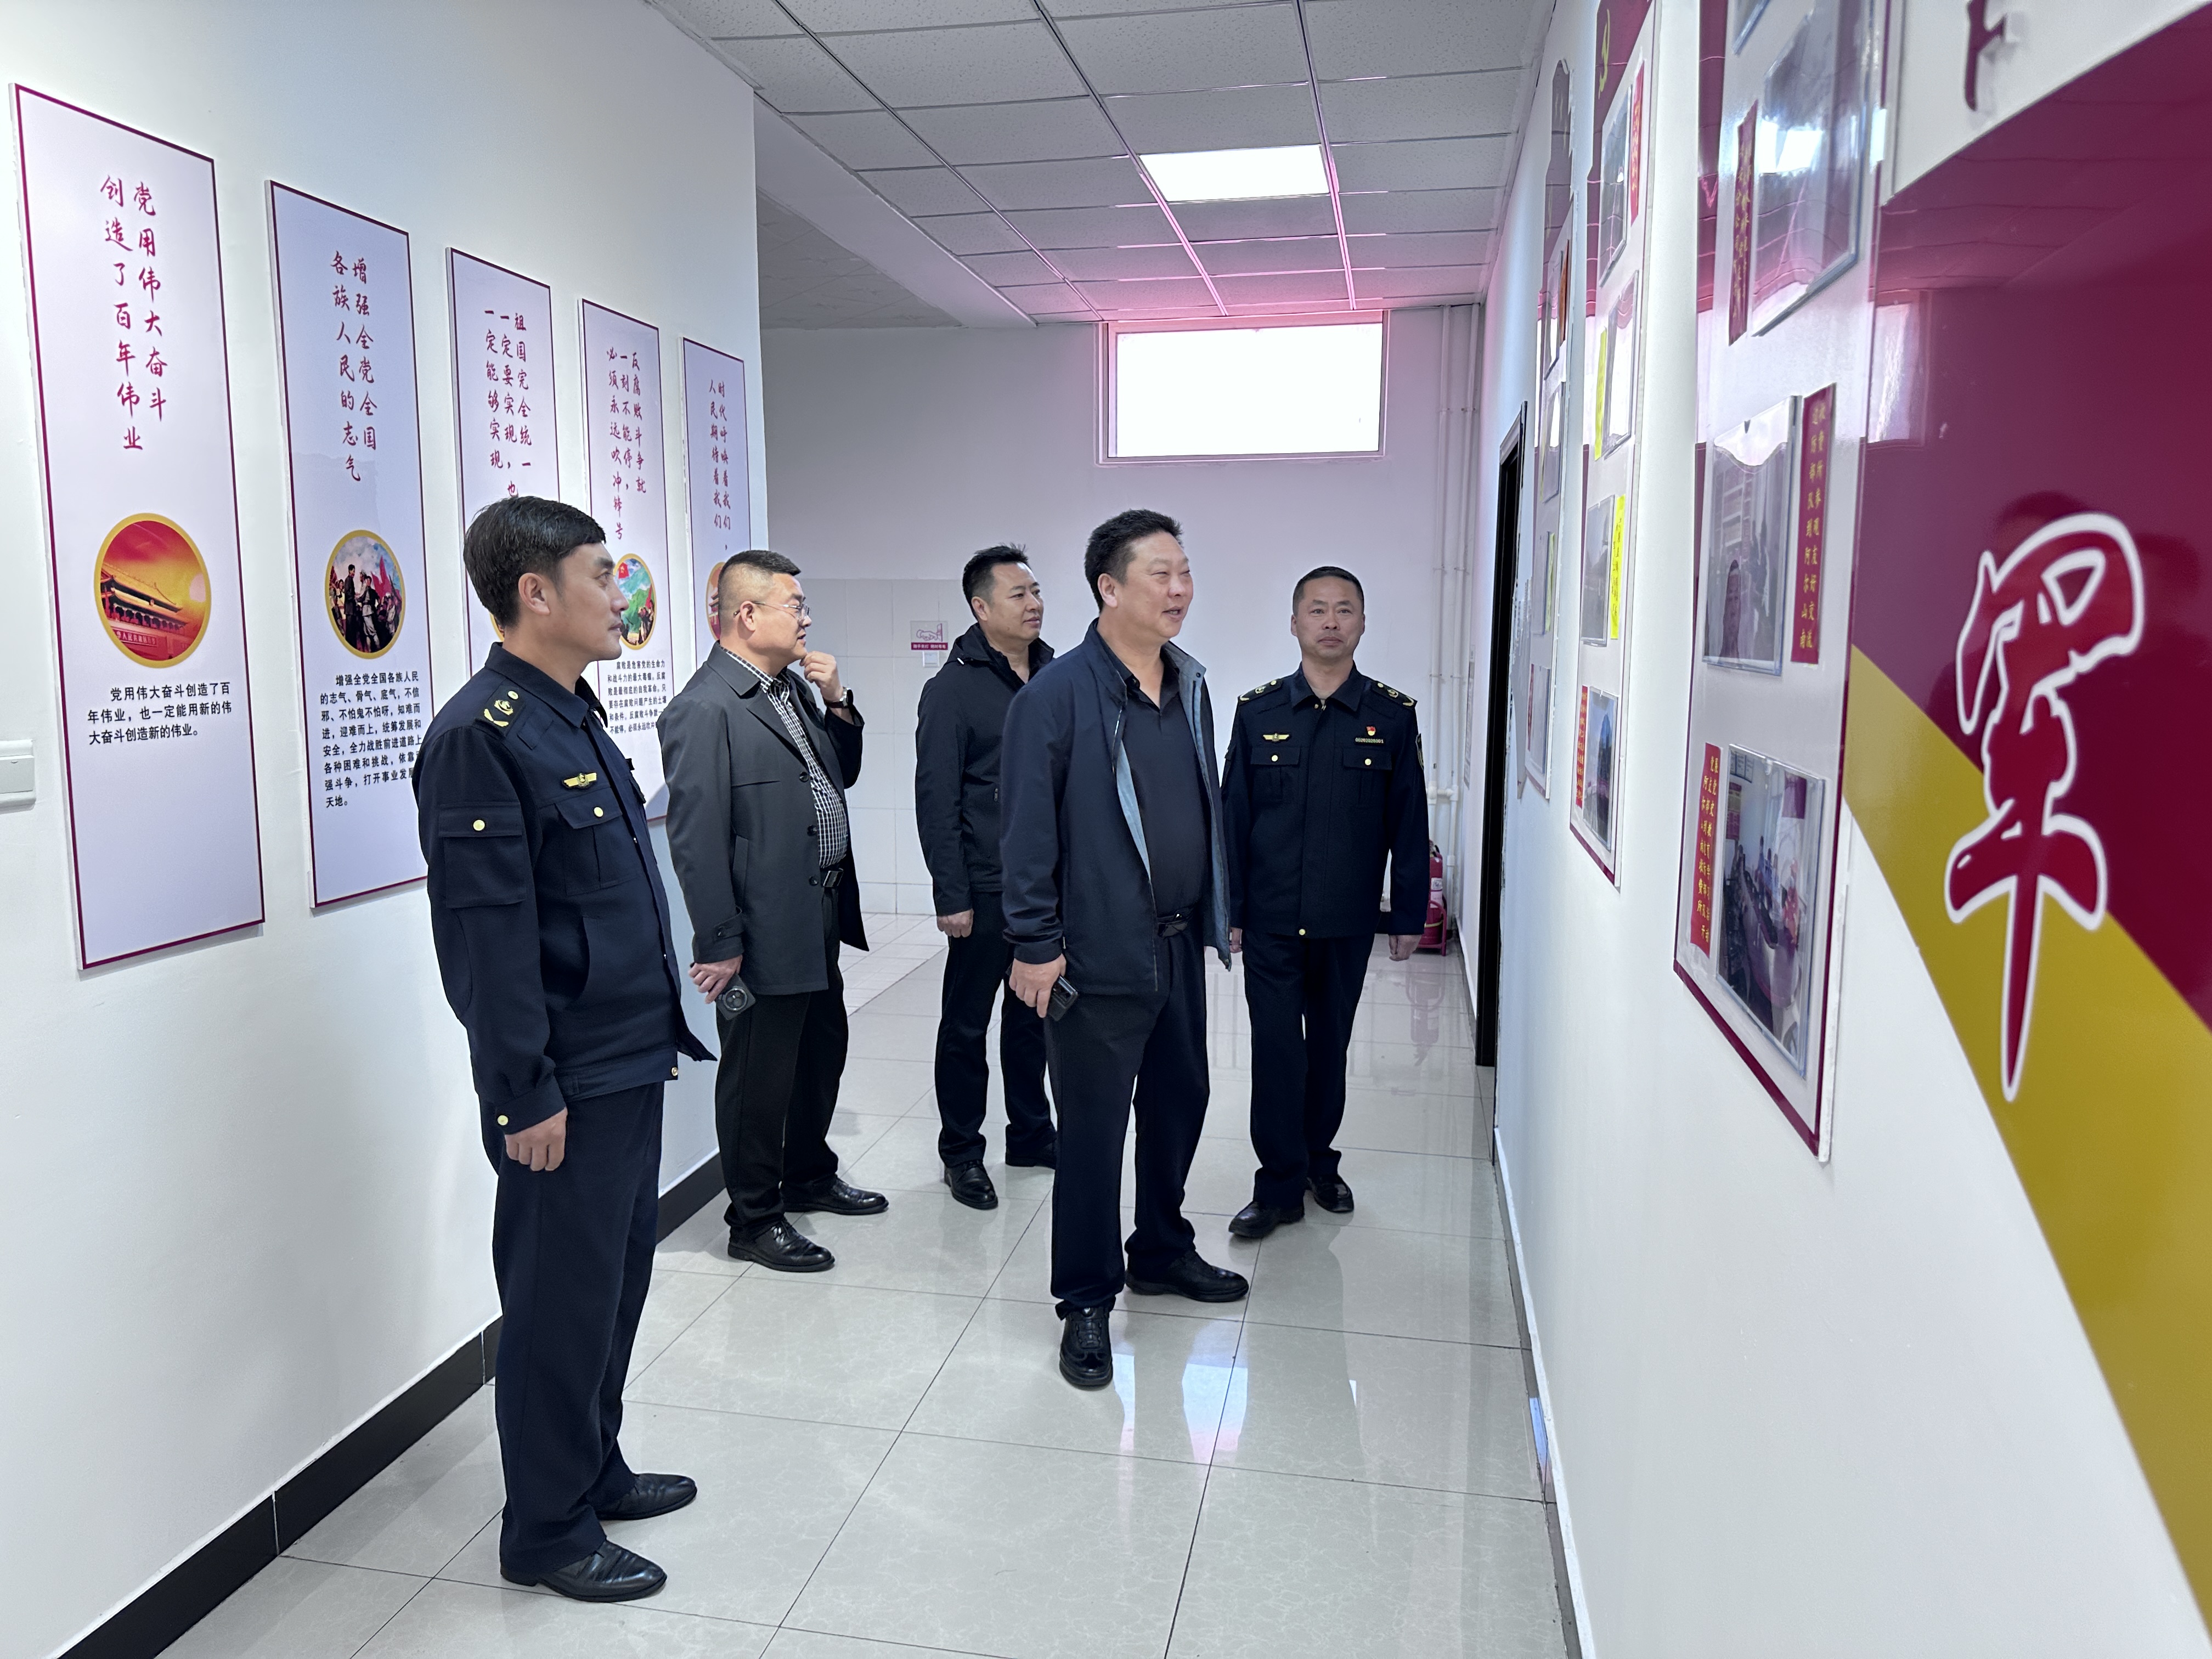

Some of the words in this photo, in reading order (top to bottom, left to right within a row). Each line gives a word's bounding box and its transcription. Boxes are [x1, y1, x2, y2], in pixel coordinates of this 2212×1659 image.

[100, 175, 143, 450] 创造了百年伟业
[133, 182, 168, 421] 党用伟大奋斗
[330, 250, 360, 482] 各族人民的志气
[352, 258, 377, 450] 增强全党全国
[484, 309, 504, 469] 一定能够实现
[514, 313, 532, 467] 祖国完全统一
[607, 346, 623, 540] 必须永远吹冲锋号
[631, 352, 646, 494] 反腐败斗争就
[708, 379, 722, 529] 人民期待着我们
[110, 682, 230, 701] 党用伟大奋斗创造了百
[320, 687, 419, 704] 的志气、骨气、底气，不信
[336, 671, 419, 686] 增强全党全国各族人民
[616, 659, 665, 670] 腐败是危害党的生命力
[87, 701, 232, 724] 年伟业，也一定能用新的伟
[89, 723, 198, 745] 大奋斗创造新的伟业。
[322, 719, 421, 739] 进，迎难而上，统筹发展和
[323, 735, 422, 757] 安全，全力战胜前进道路上
[326, 795, 348, 808] 天地。
